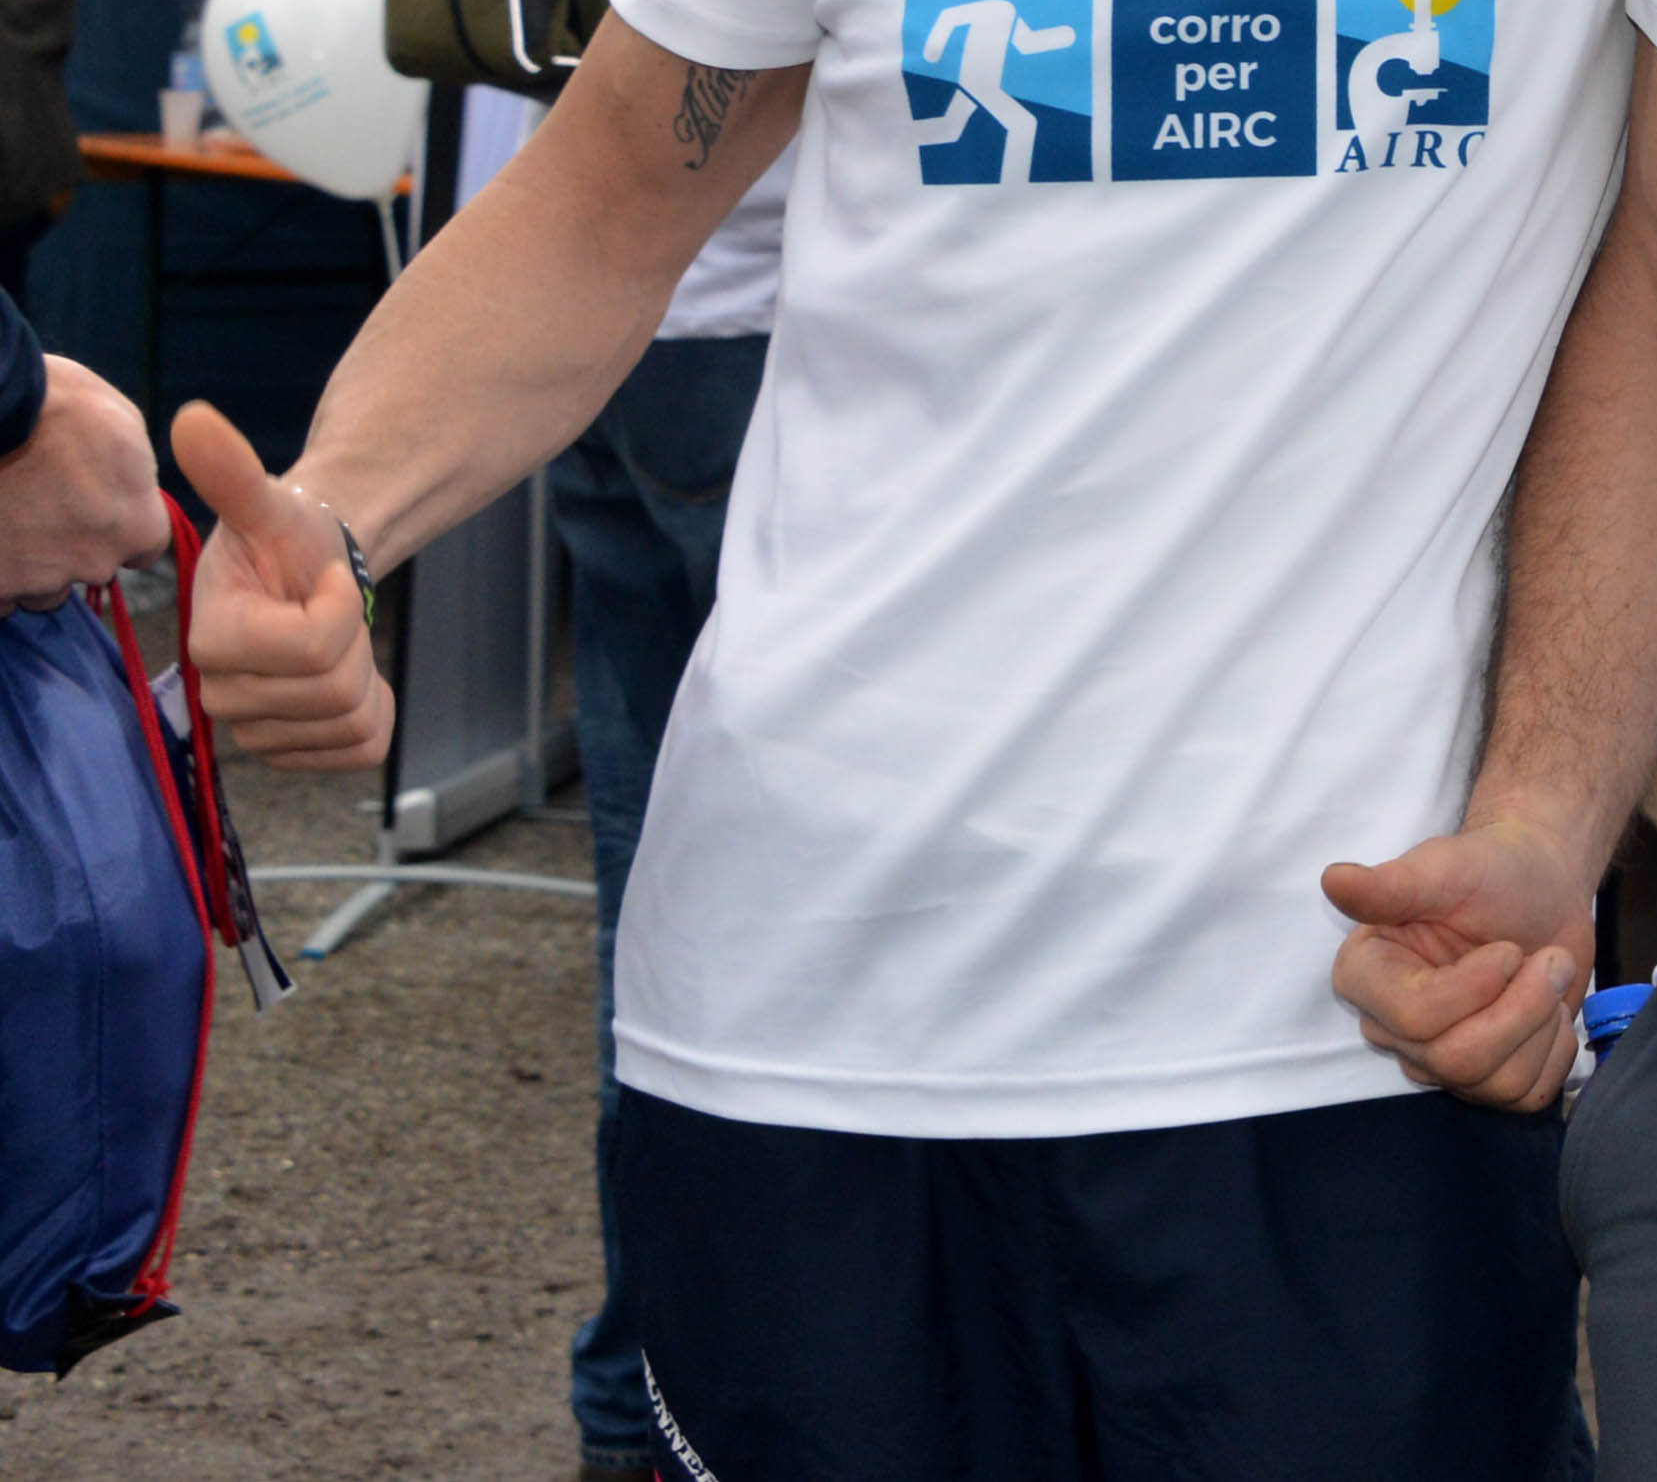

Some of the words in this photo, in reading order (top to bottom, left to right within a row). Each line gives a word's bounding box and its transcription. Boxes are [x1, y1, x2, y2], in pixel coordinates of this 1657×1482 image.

[1149, 14, 1281, 44] corro
[1176, 59, 1258, 101] per
[1153, 111, 1277, 150] AIRC
[1335, 130, 1486, 173] AIRC
